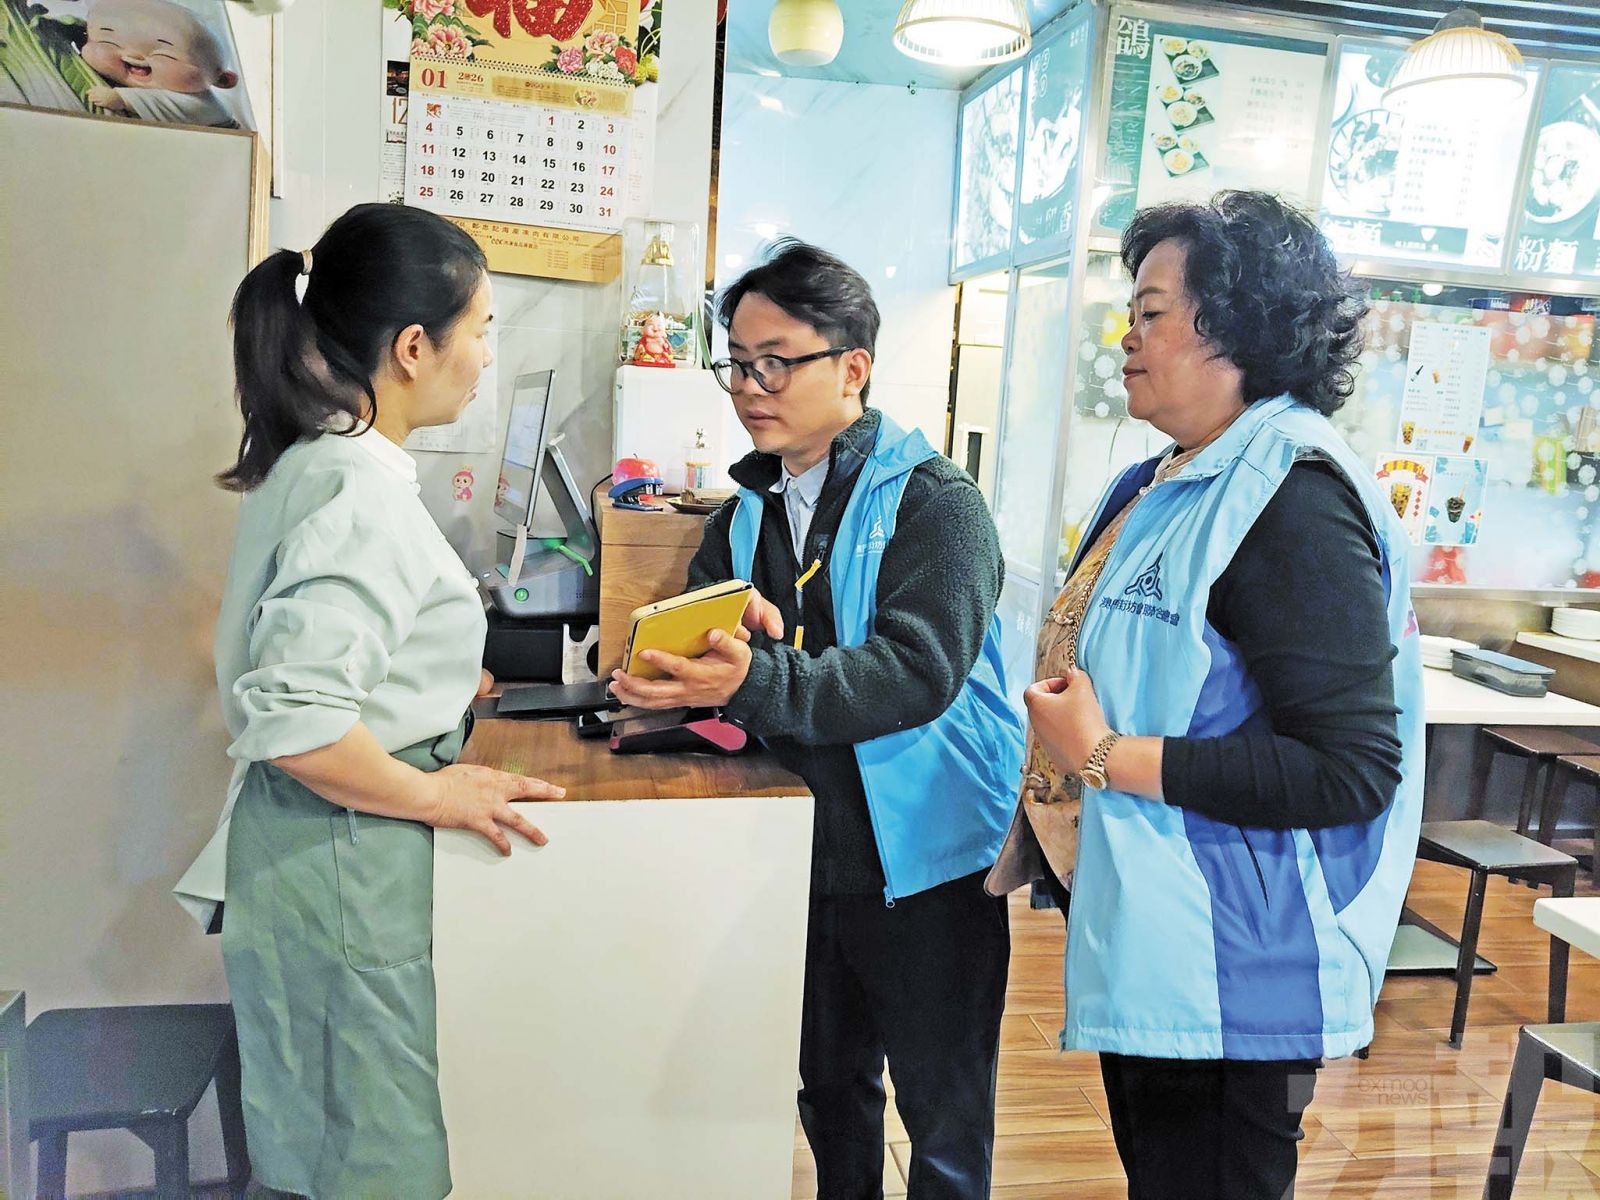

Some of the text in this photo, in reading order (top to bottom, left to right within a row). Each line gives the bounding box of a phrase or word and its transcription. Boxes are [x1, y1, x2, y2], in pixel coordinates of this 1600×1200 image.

[1116, 17, 1150, 60] 鴿
[421, 68, 447, 89] 01
[457, 72, 484, 83] 2026
[426, 123, 616, 154] 4 5 6 7 8 9 10
[548, 116, 614, 133] 1 2 3
[422, 144, 614, 175] 11 12 13 14 15 16 17
[421, 165, 613, 196] 18 19 20 21 22 23 24
[420, 187, 612, 217] 25 26 27 28 29 30 31
[1513, 235, 1579, 275] 粉麵
